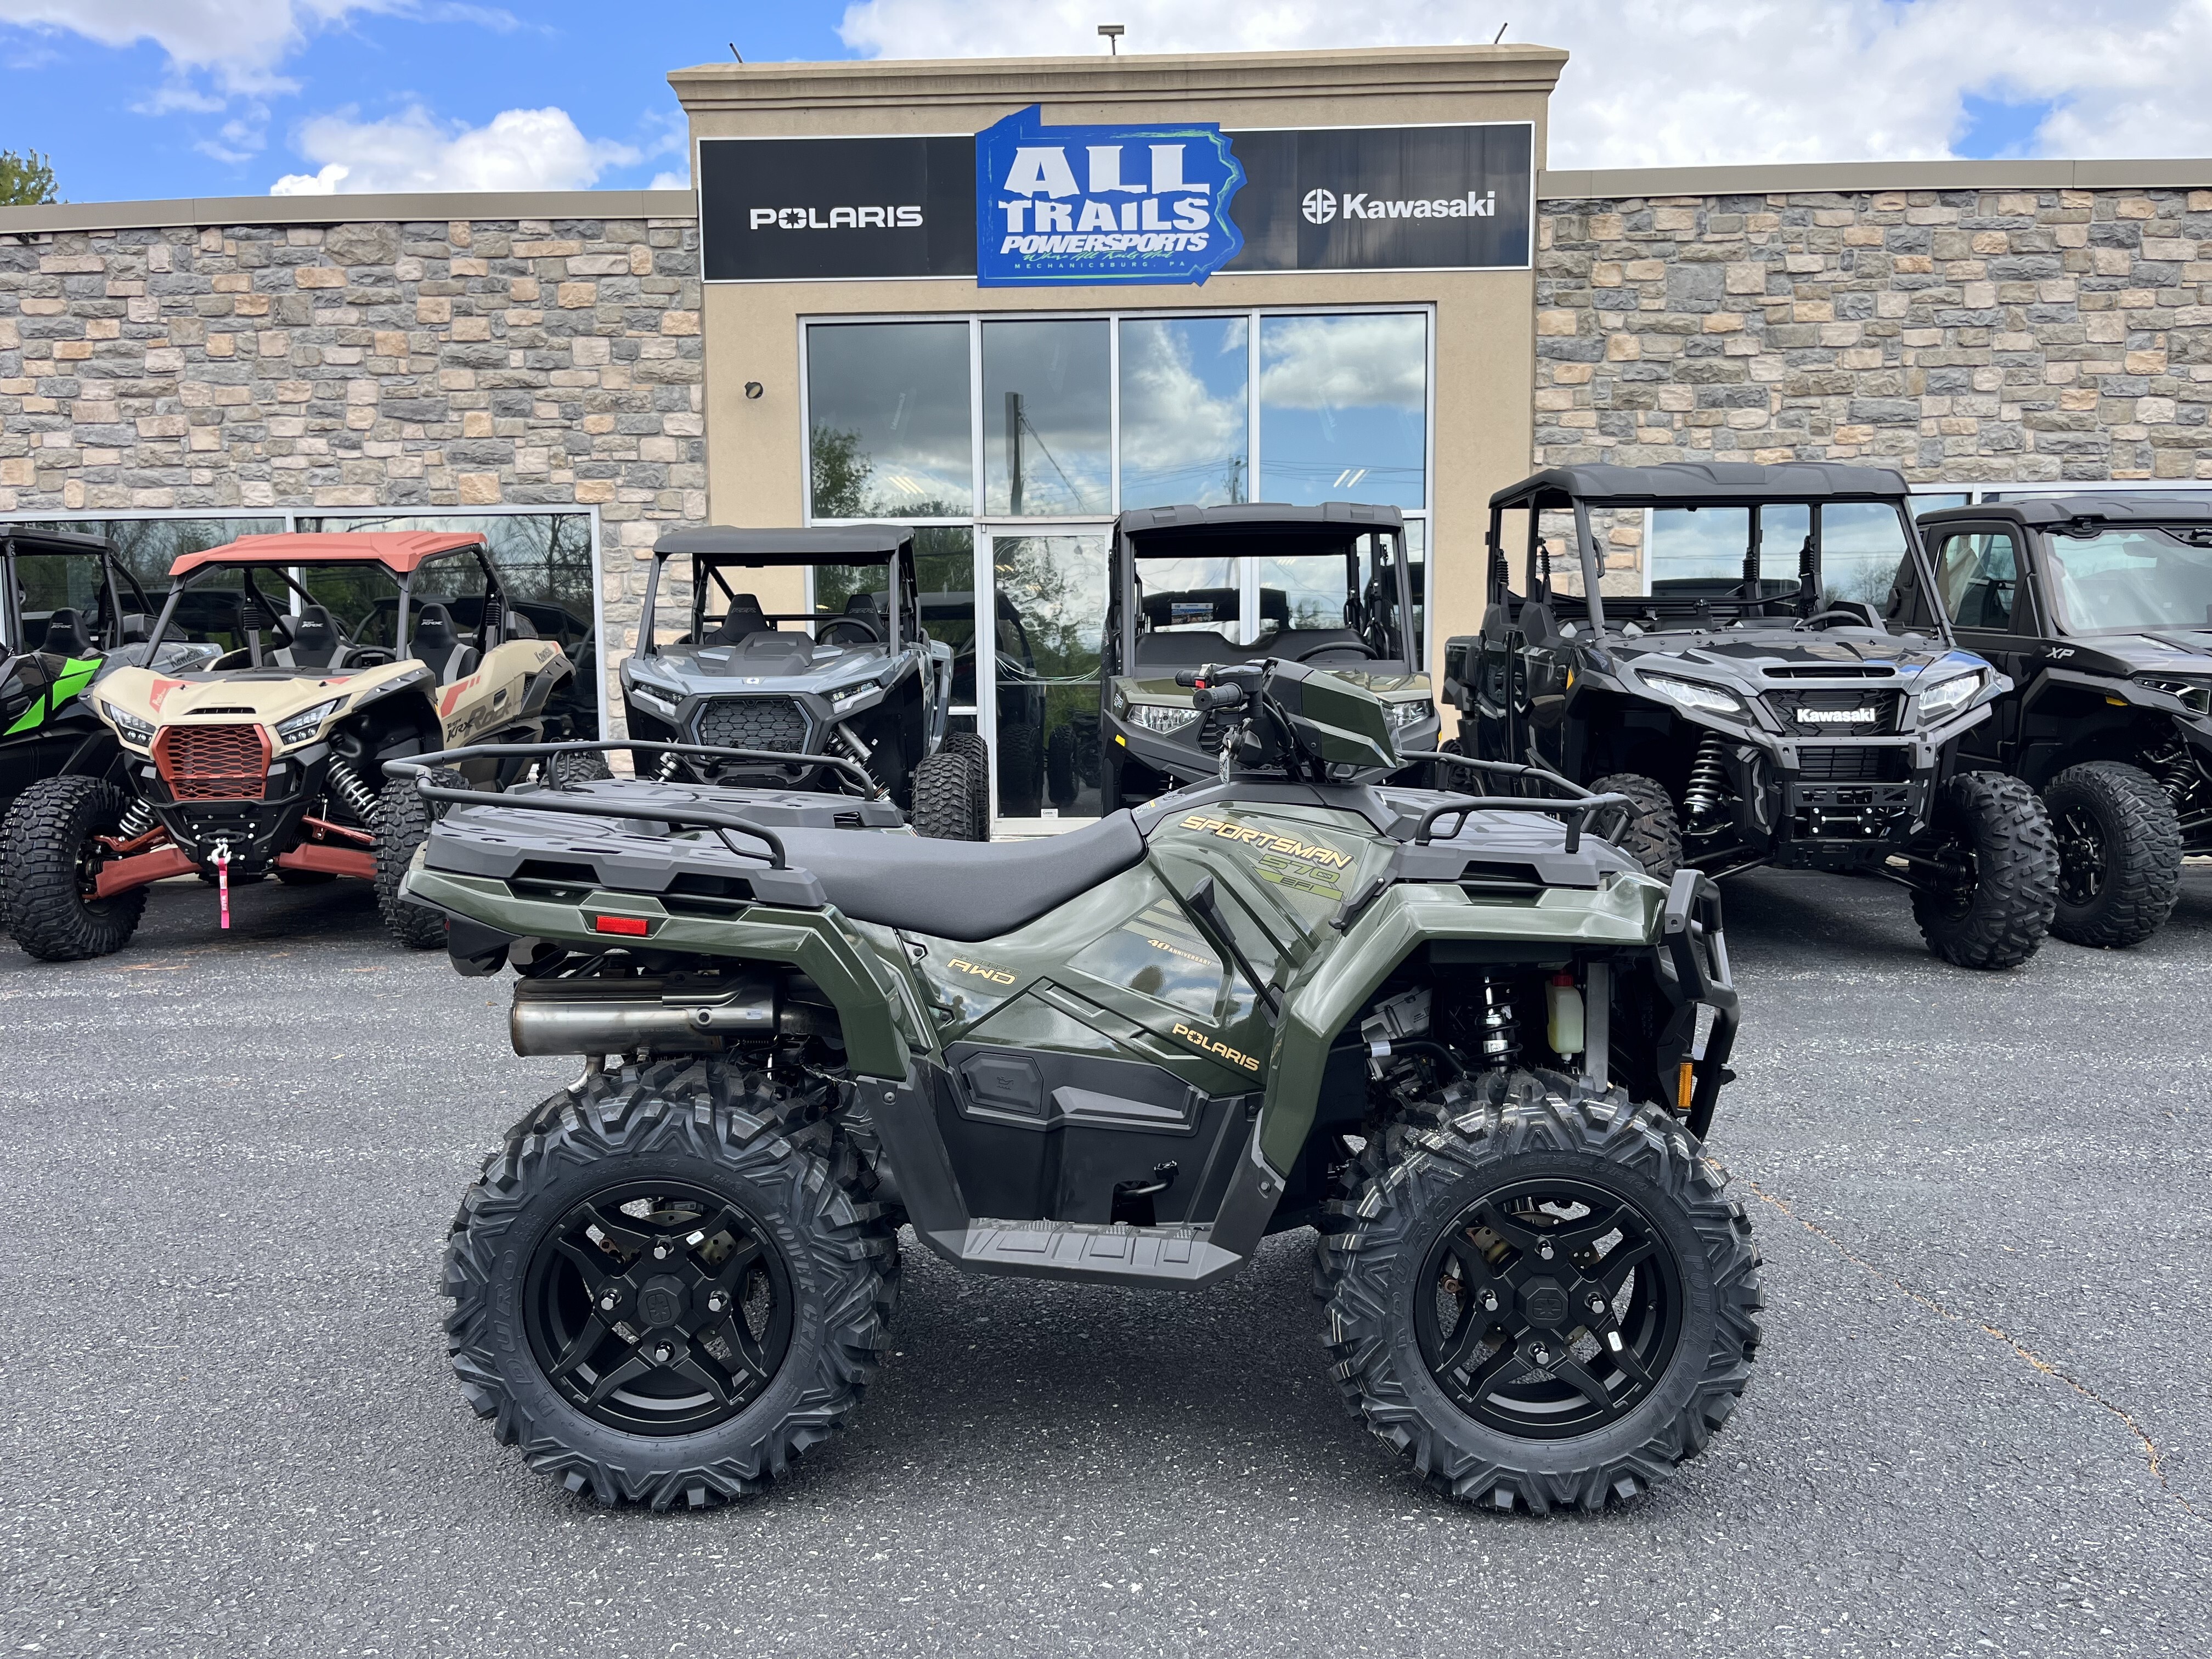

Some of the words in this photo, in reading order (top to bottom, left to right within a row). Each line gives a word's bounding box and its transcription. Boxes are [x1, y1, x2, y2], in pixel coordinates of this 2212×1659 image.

[1003, 144, 1210, 199] ALL
[750, 206, 923, 229] POLARIS
[998, 198, 1210, 233] TRAILS
[1343, 191, 1496, 219] Kawasaki
[1000, 233, 1209, 254] POWERSPORTS
[1070, 250, 1098, 261] All
[2045, 647, 2075, 659] XP
[1797, 708, 1875, 722] Kawasaki
[1179, 815, 1354, 870] SPORTSMAN
[1259, 854, 1340, 883] 570
[1279, 877, 1314, 891] EFI
[946, 957, 1016, 985] AWD
[1169, 948, 1211, 966] ANNIVERSARY
[1172, 1023, 1260, 1071] POLARIS
[763, 1212, 817, 1294] POWER
[797, 1303, 818, 1368] GRIP
[1682, 1254, 1712, 1353] POWER
[1650, 1361, 1695, 1427] GRIP
